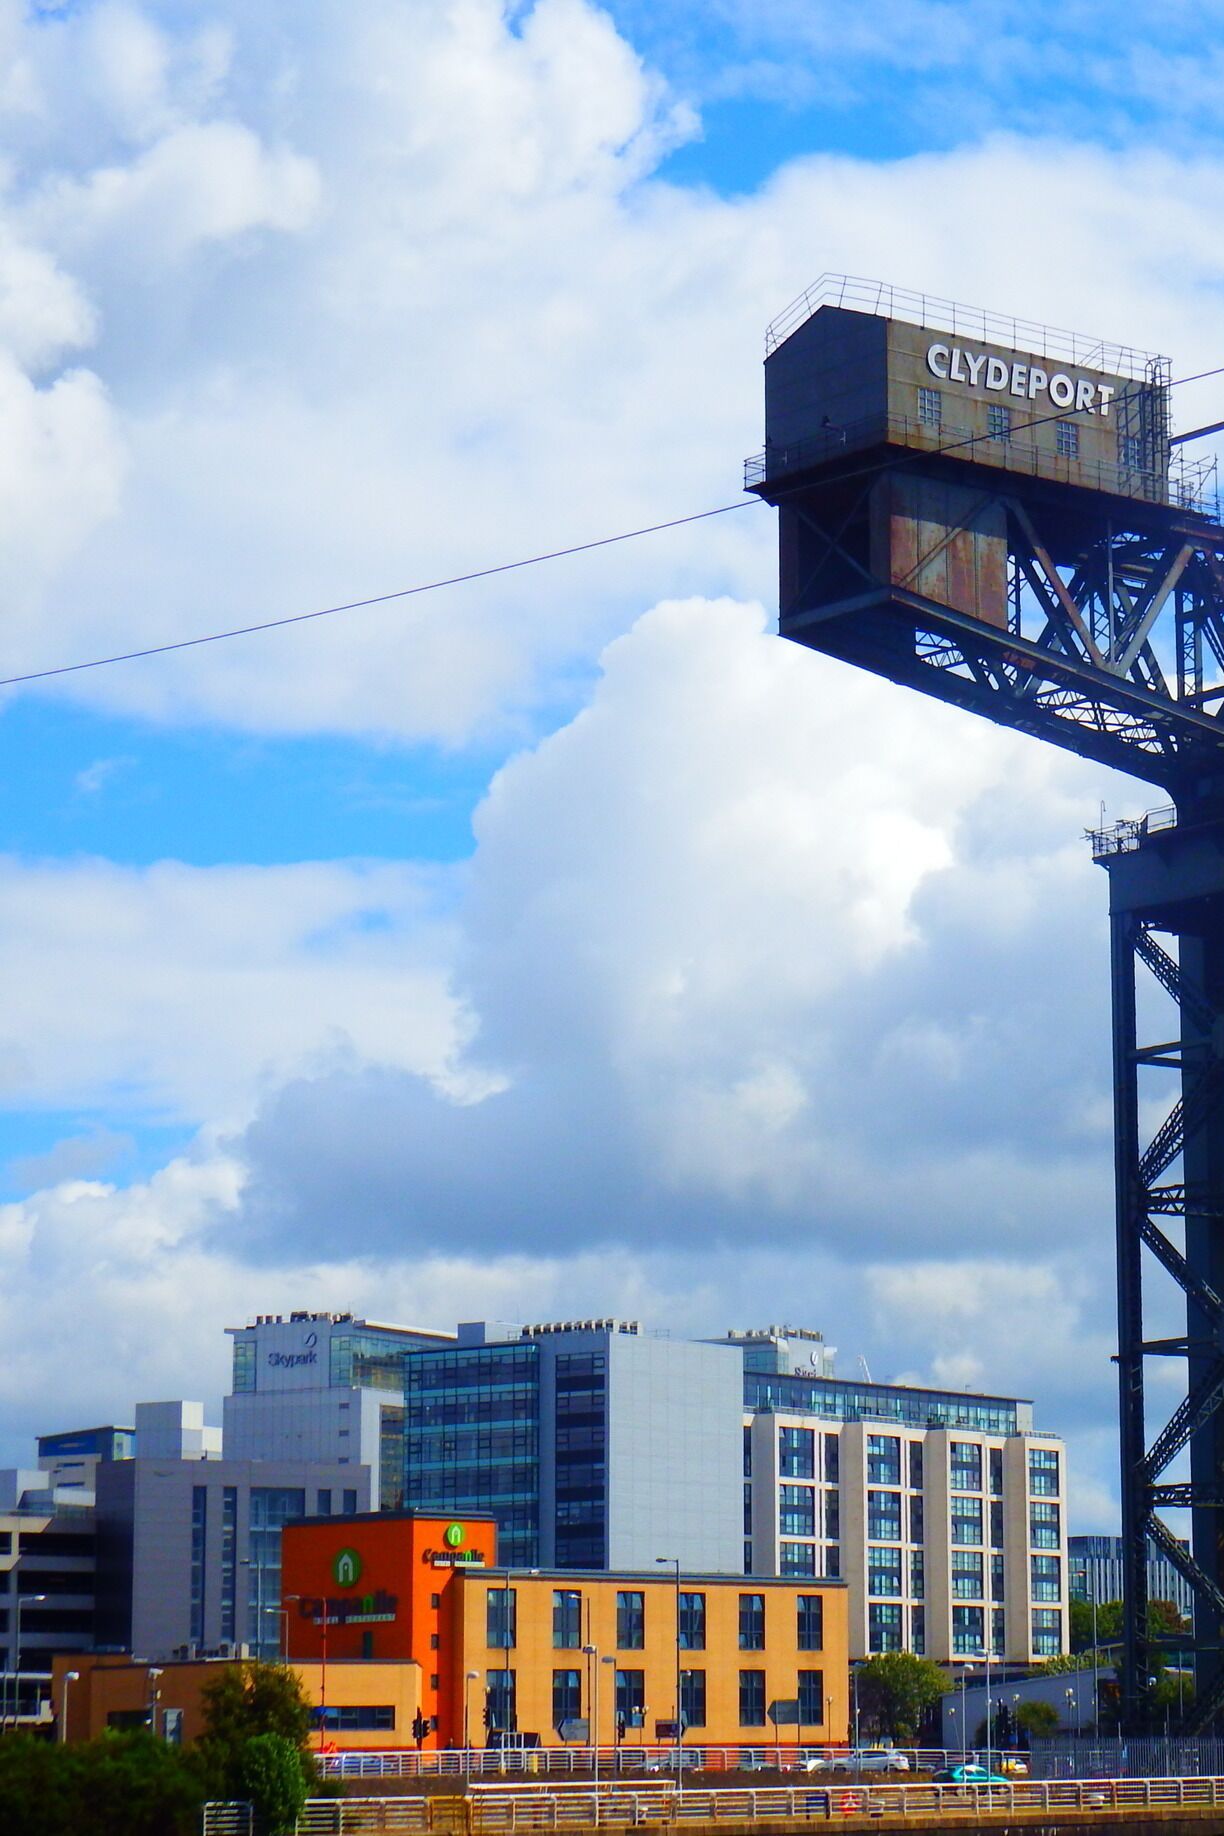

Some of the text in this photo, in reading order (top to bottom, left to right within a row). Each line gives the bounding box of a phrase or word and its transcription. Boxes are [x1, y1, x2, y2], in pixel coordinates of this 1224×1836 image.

[926, 343, 1115, 417] CLYDEPORT
[268, 1350, 318, 1368] Skypark
[422, 1548, 485, 1567] Campanile
